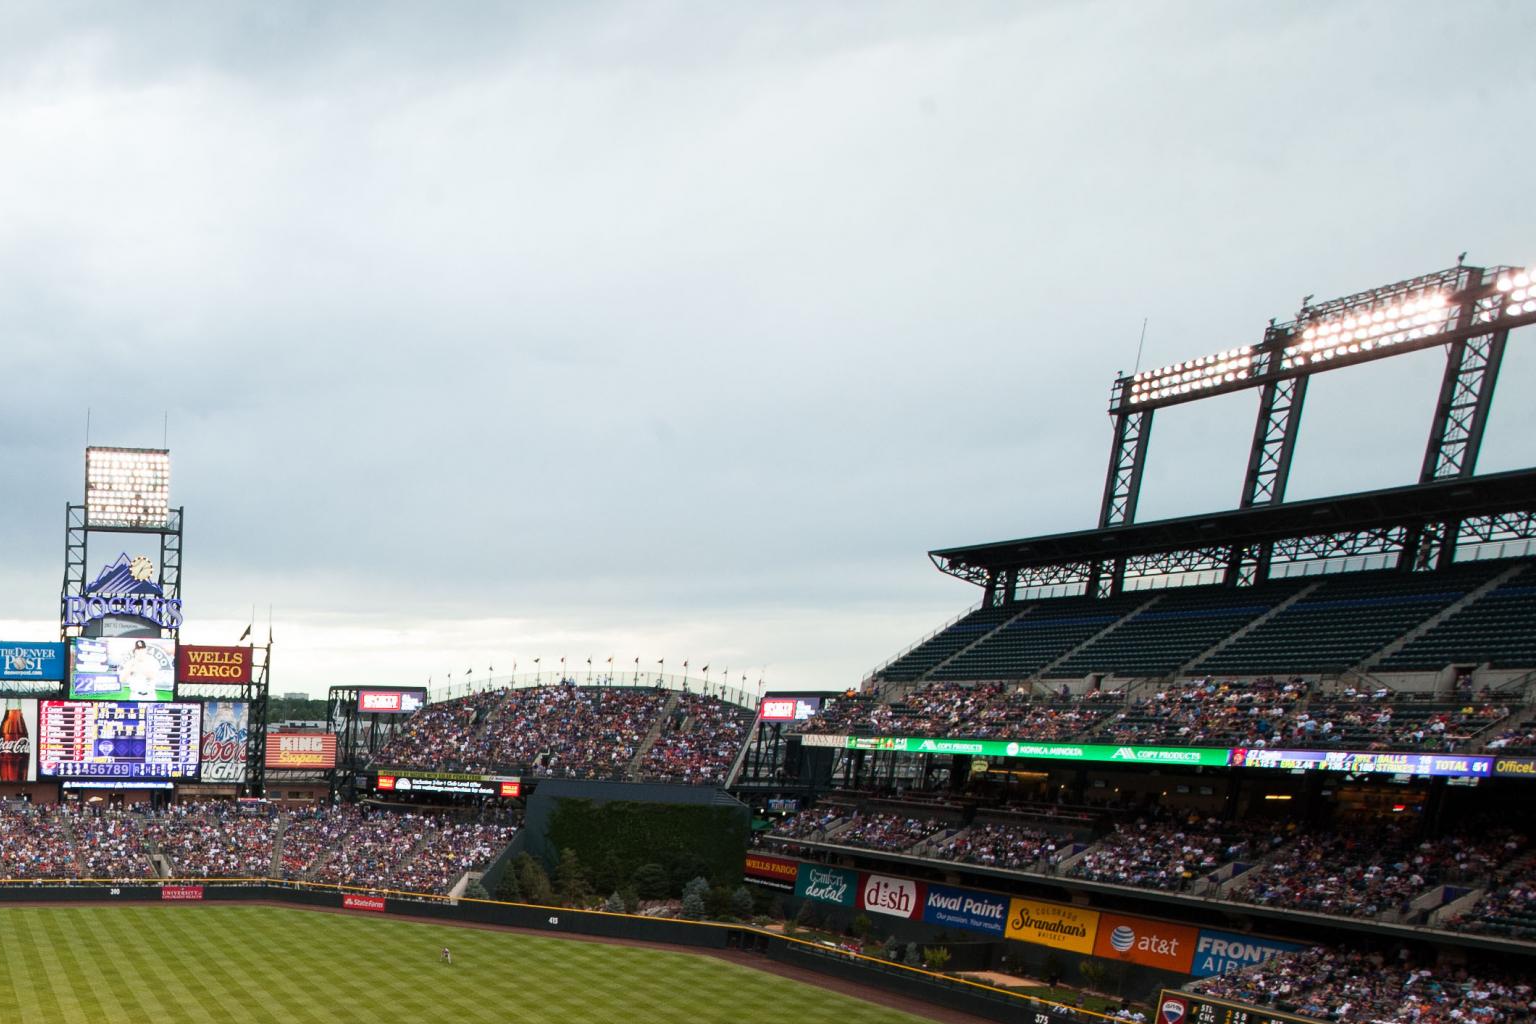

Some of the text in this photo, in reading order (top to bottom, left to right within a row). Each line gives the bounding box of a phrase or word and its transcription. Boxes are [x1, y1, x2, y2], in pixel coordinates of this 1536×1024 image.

[63, 595, 183, 629] ROCKIES
[0, 647, 55, 657] THE DENVER
[188, 651, 243, 664] WELLS
[5, 656, 44, 670] POST
[188, 665, 242, 678] FARGO
[75, 679, 94, 692] 22
[202, 731, 247, 762] Coors
[280, 736, 323, 751] KING
[1137, 750, 1201, 761] COPY PRODUCTS
[1435, 760, 1488, 772] TOTAL 51
[745, 858, 798, 875] WELLS FARGO
[809, 868, 843, 885] Comfort
[805, 883, 847, 903] dental
[866, 882, 911, 912] dish
[928, 892, 1004, 919] Kwal Paint
[1035, 903, 1077, 922] COLORADO
[936, 912, 946, 920] Our
[1011, 908, 1087, 938] Stranahan's
[1137, 934, 1180, 957] at&t
[1199, 1013, 1214, 1023] CHC
[1201, 1004, 1247, 1021] STL 58
